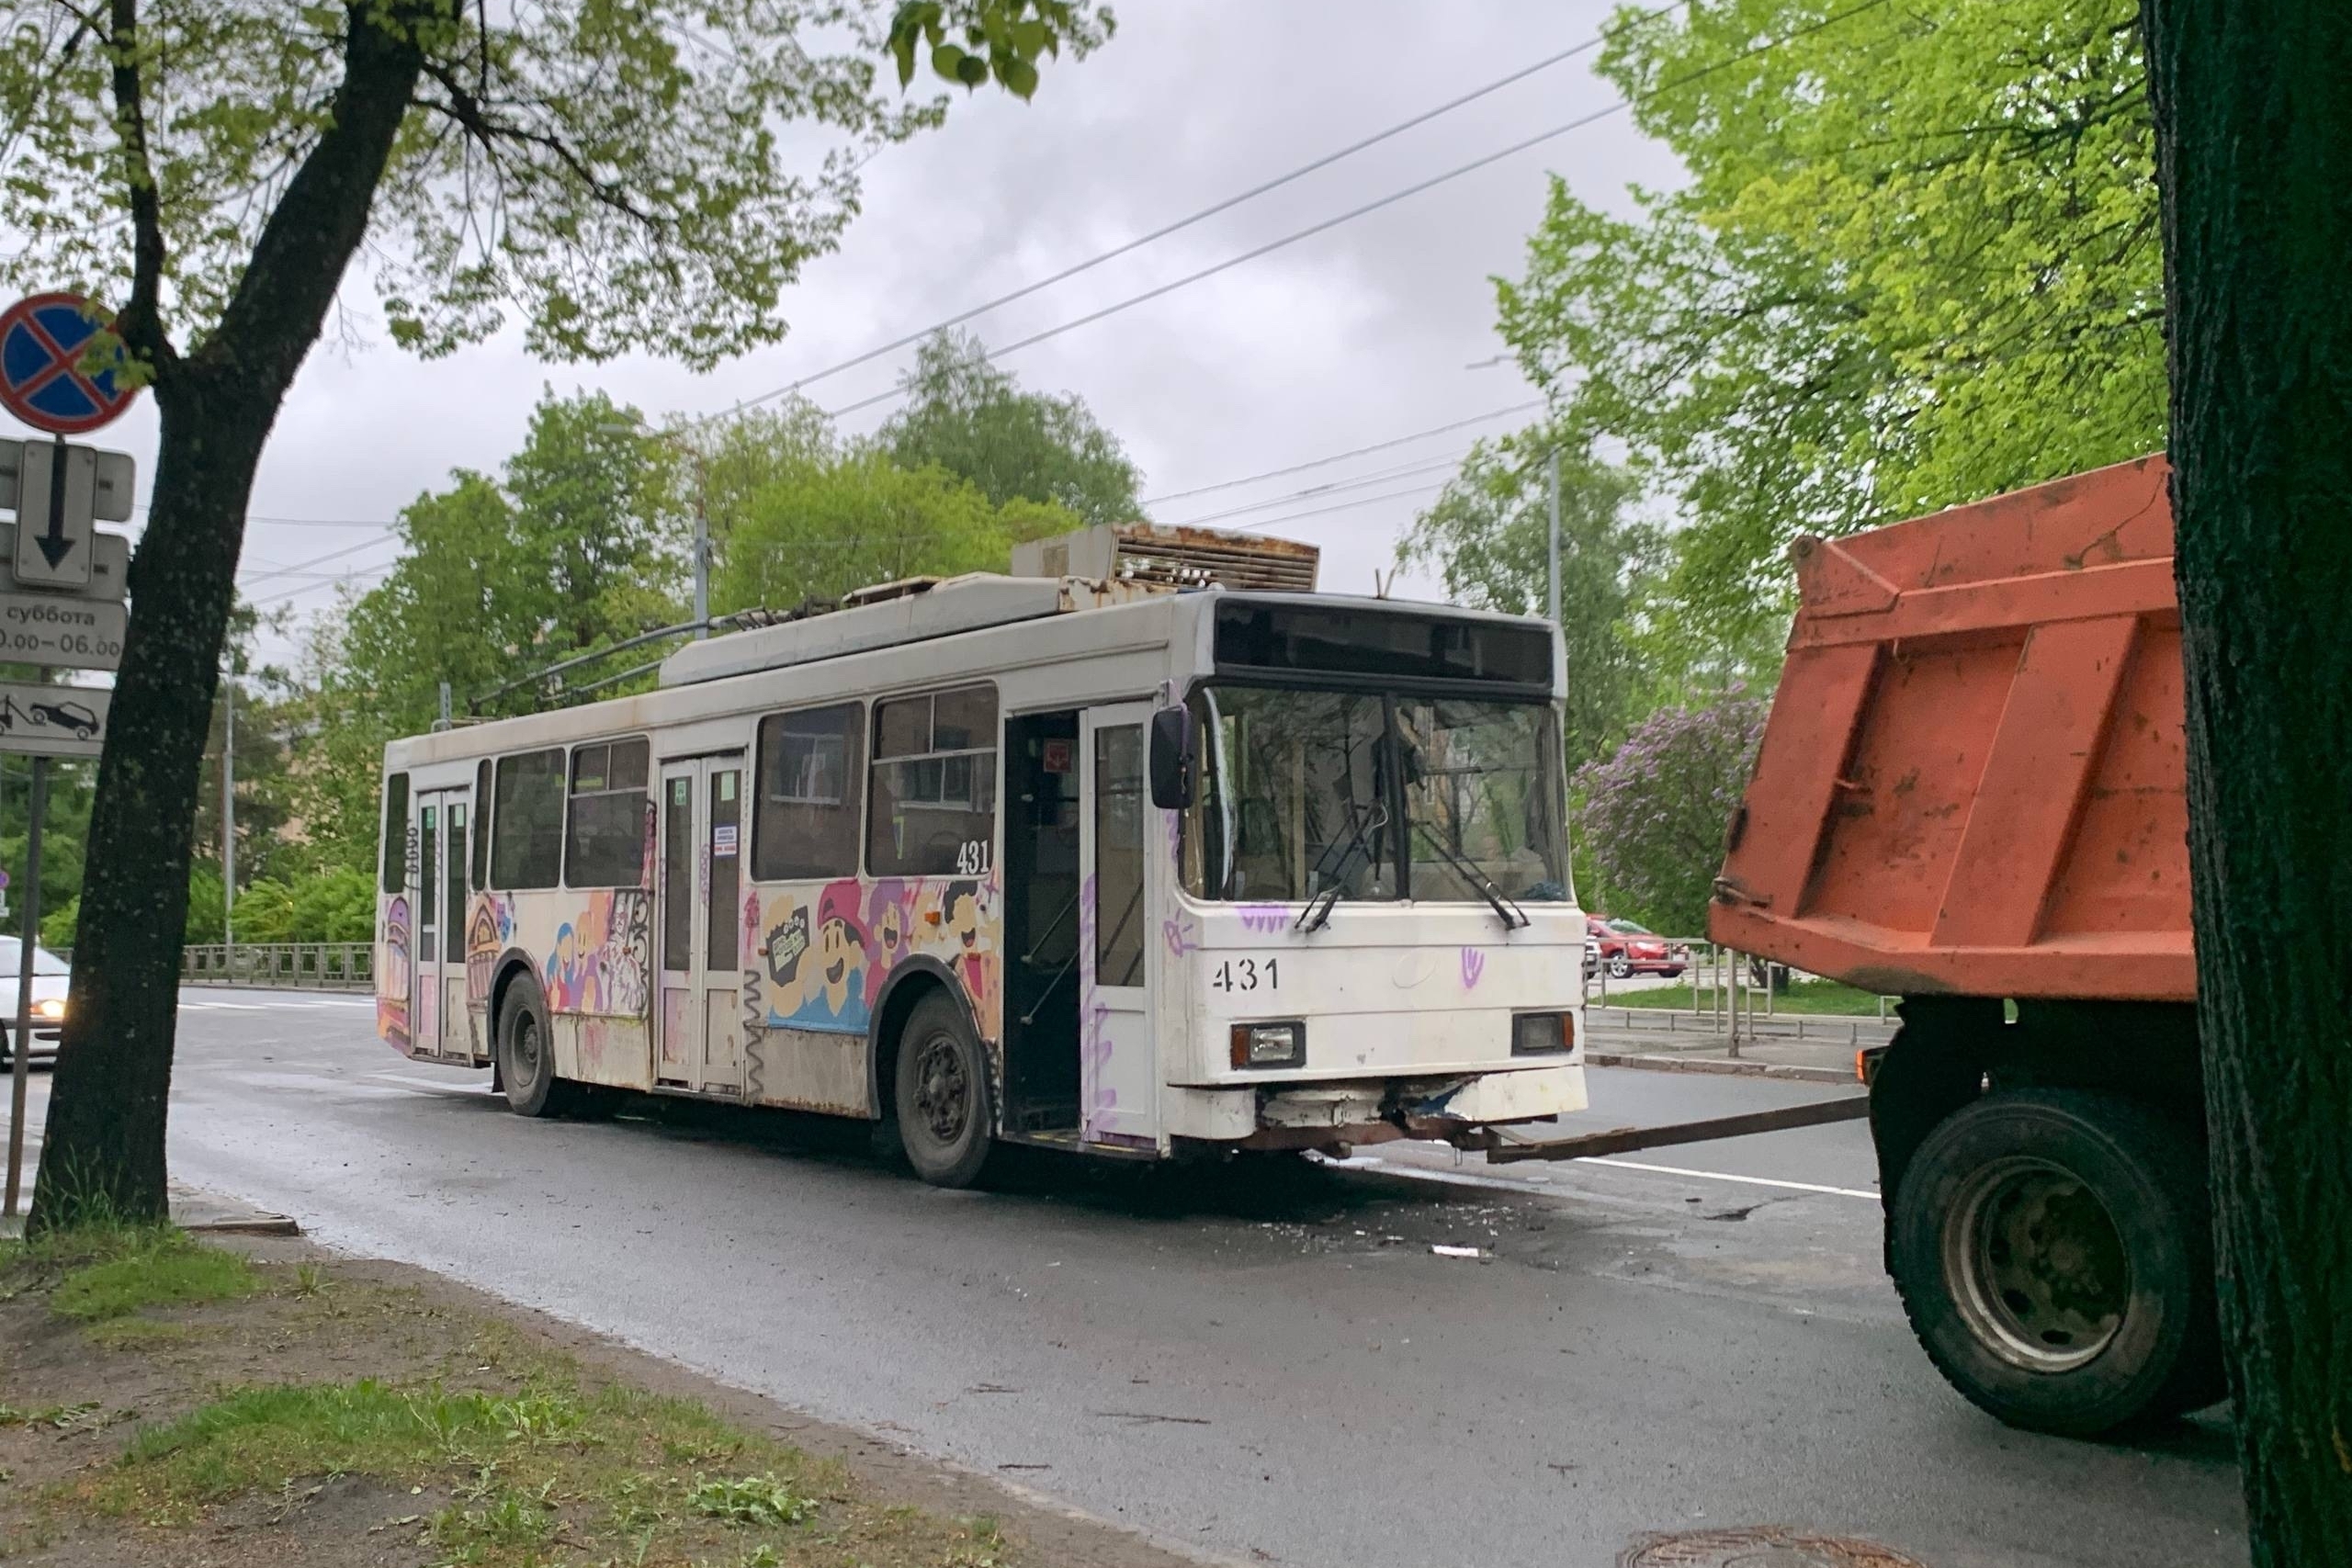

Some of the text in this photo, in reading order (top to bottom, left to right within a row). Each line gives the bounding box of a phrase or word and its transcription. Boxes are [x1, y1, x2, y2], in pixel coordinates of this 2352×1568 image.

[6, 604, 96, 626] суббота
[956, 840, 989, 874] 431
[1212, 958, 1278, 992] 431
